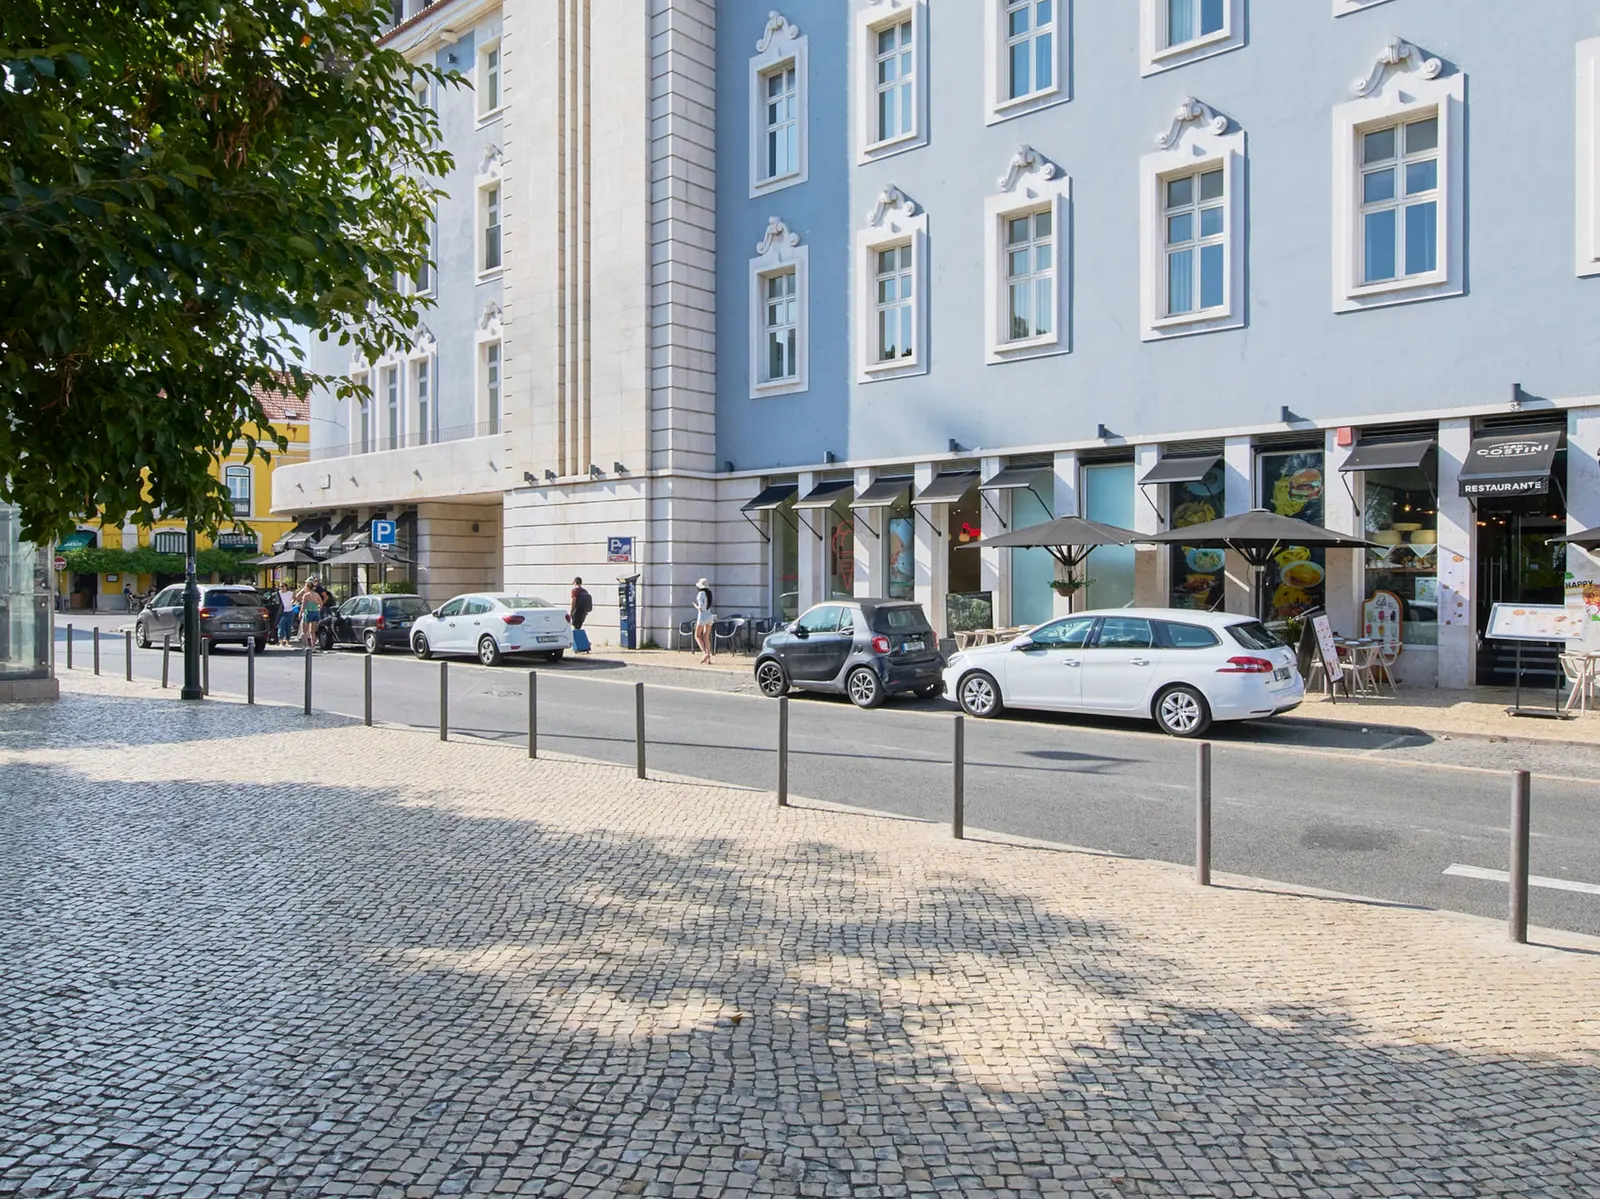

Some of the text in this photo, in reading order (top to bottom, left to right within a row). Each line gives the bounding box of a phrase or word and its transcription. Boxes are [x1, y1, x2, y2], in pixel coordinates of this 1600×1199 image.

[1476, 443, 1549, 456] COSTINI
[1464, 481, 1542, 493] RESTAURANTE
[377, 522, 392, 542] P
[1565, 579, 1594, 589] HAPPY
